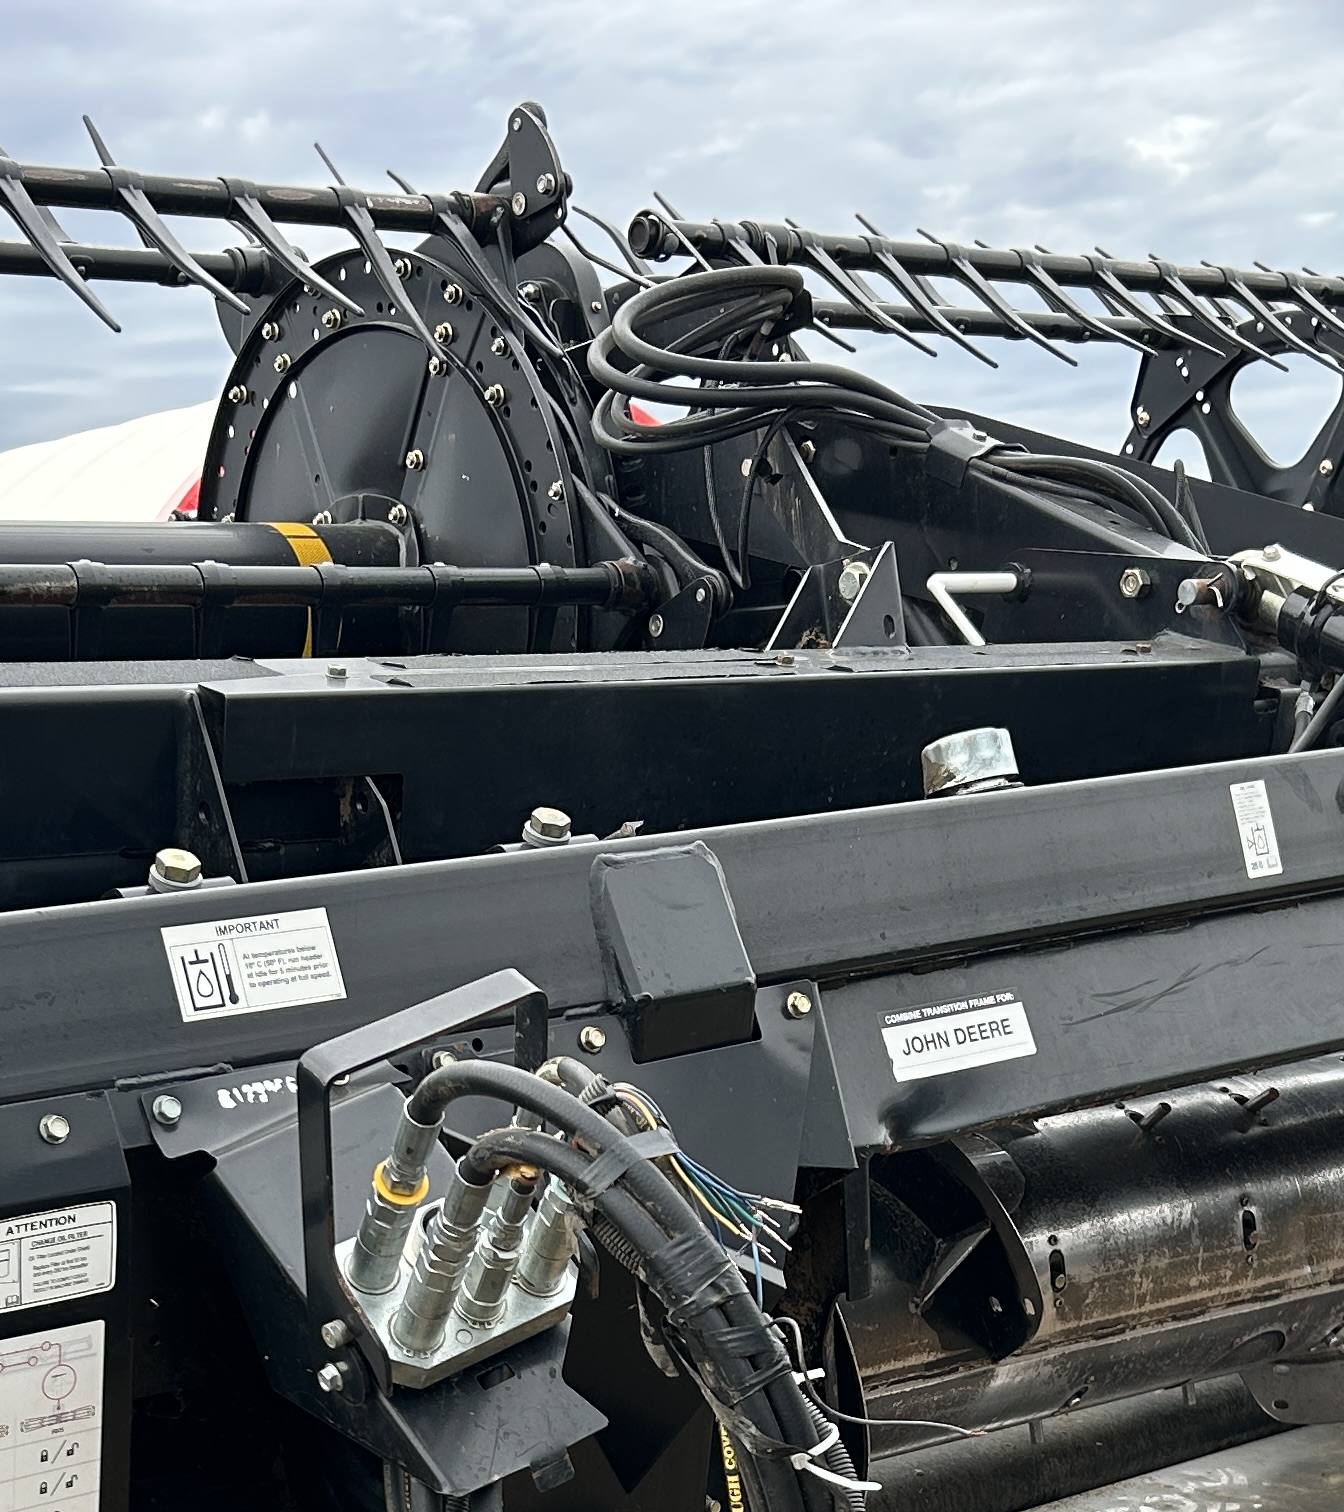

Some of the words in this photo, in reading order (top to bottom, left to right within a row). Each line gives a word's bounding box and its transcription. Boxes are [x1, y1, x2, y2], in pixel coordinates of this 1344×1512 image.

[215, 918, 280, 936] IMPORTANT
[885, 1010, 921, 1023] COMBINE
[922, 1001, 969, 1016] TRANSITION
[969, 996, 996, 1008] FRAME
[903, 1030, 950, 1056] JOHN
[955, 1018, 1014, 1044] DEERE
[6, 1214, 76, 1236] ATTENTION
